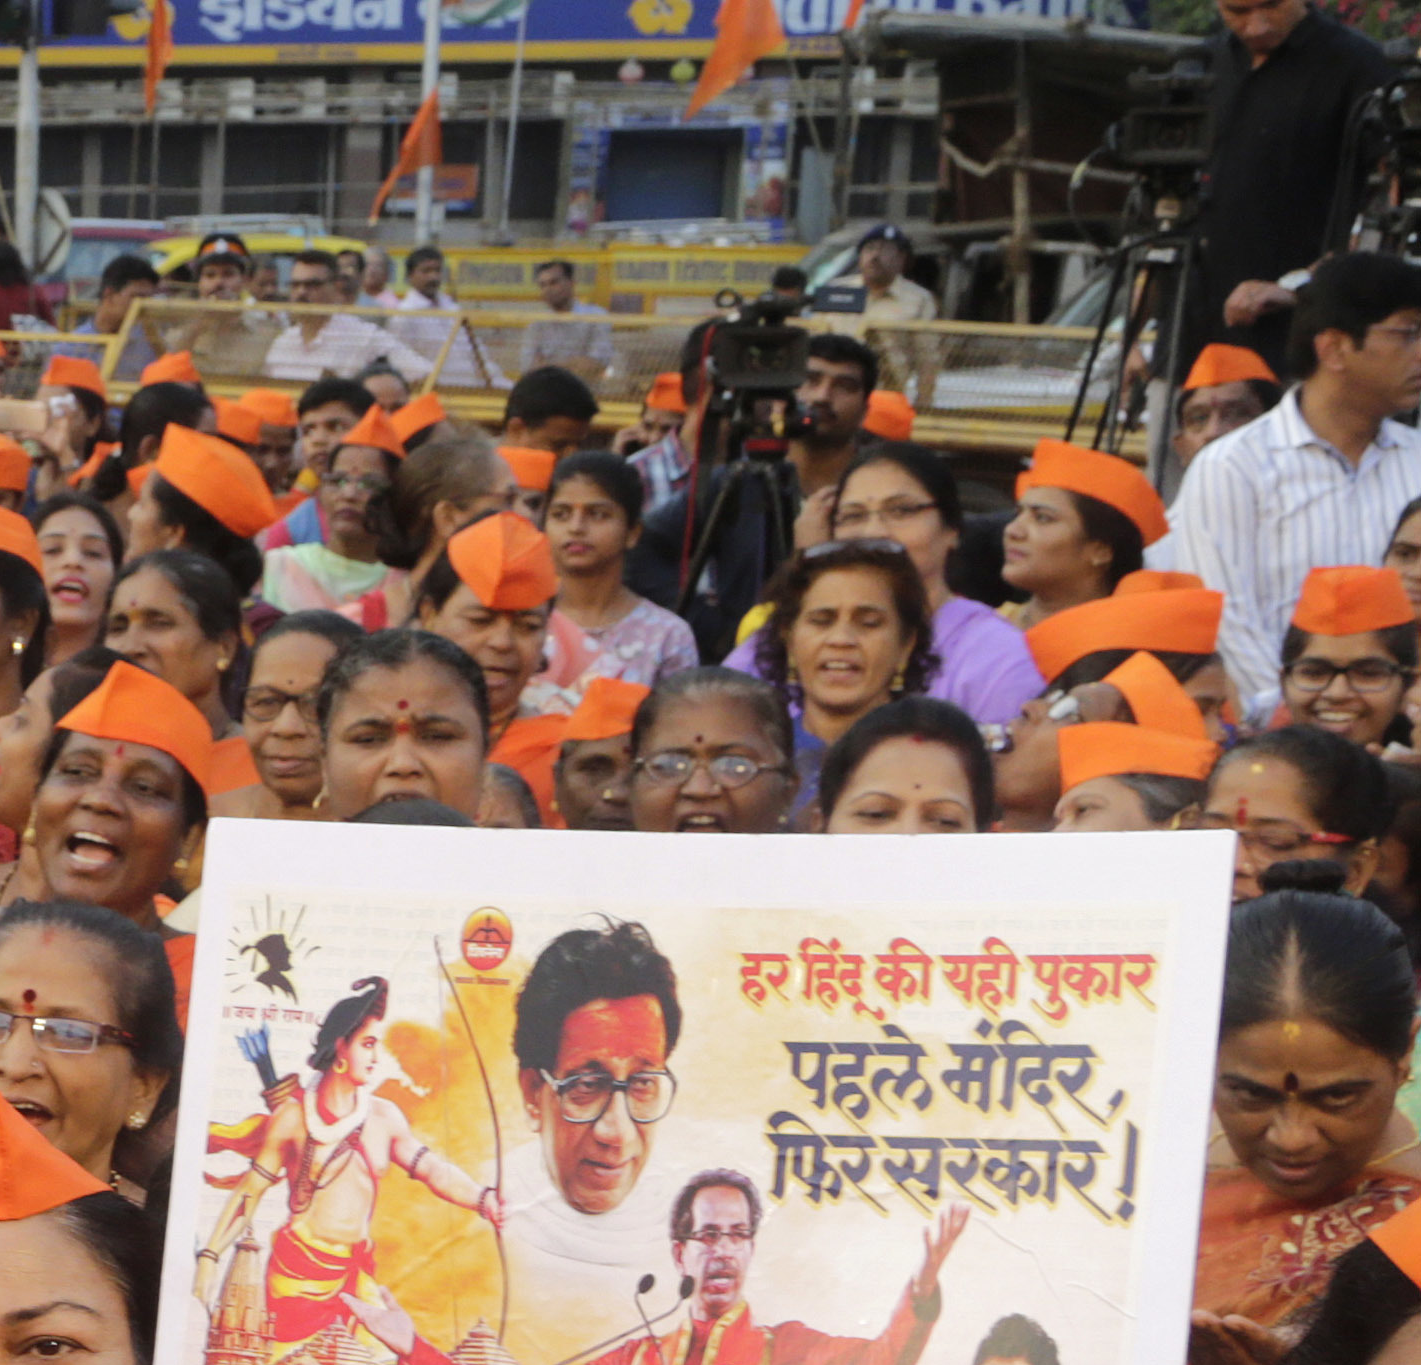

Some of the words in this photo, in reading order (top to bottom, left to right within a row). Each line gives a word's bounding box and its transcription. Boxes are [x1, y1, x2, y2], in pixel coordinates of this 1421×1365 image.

[740, 953, 791, 1006] हर
[798, 938, 885, 1021] हिंदू
[873, 938, 934, 1002] की
[938, 937, 1020, 1017] यही
[1026, 954, 1156, 1020] पुकार
[782, 1024, 935, 1133] पहले
[765, 1111, 888, 1213] फिर
